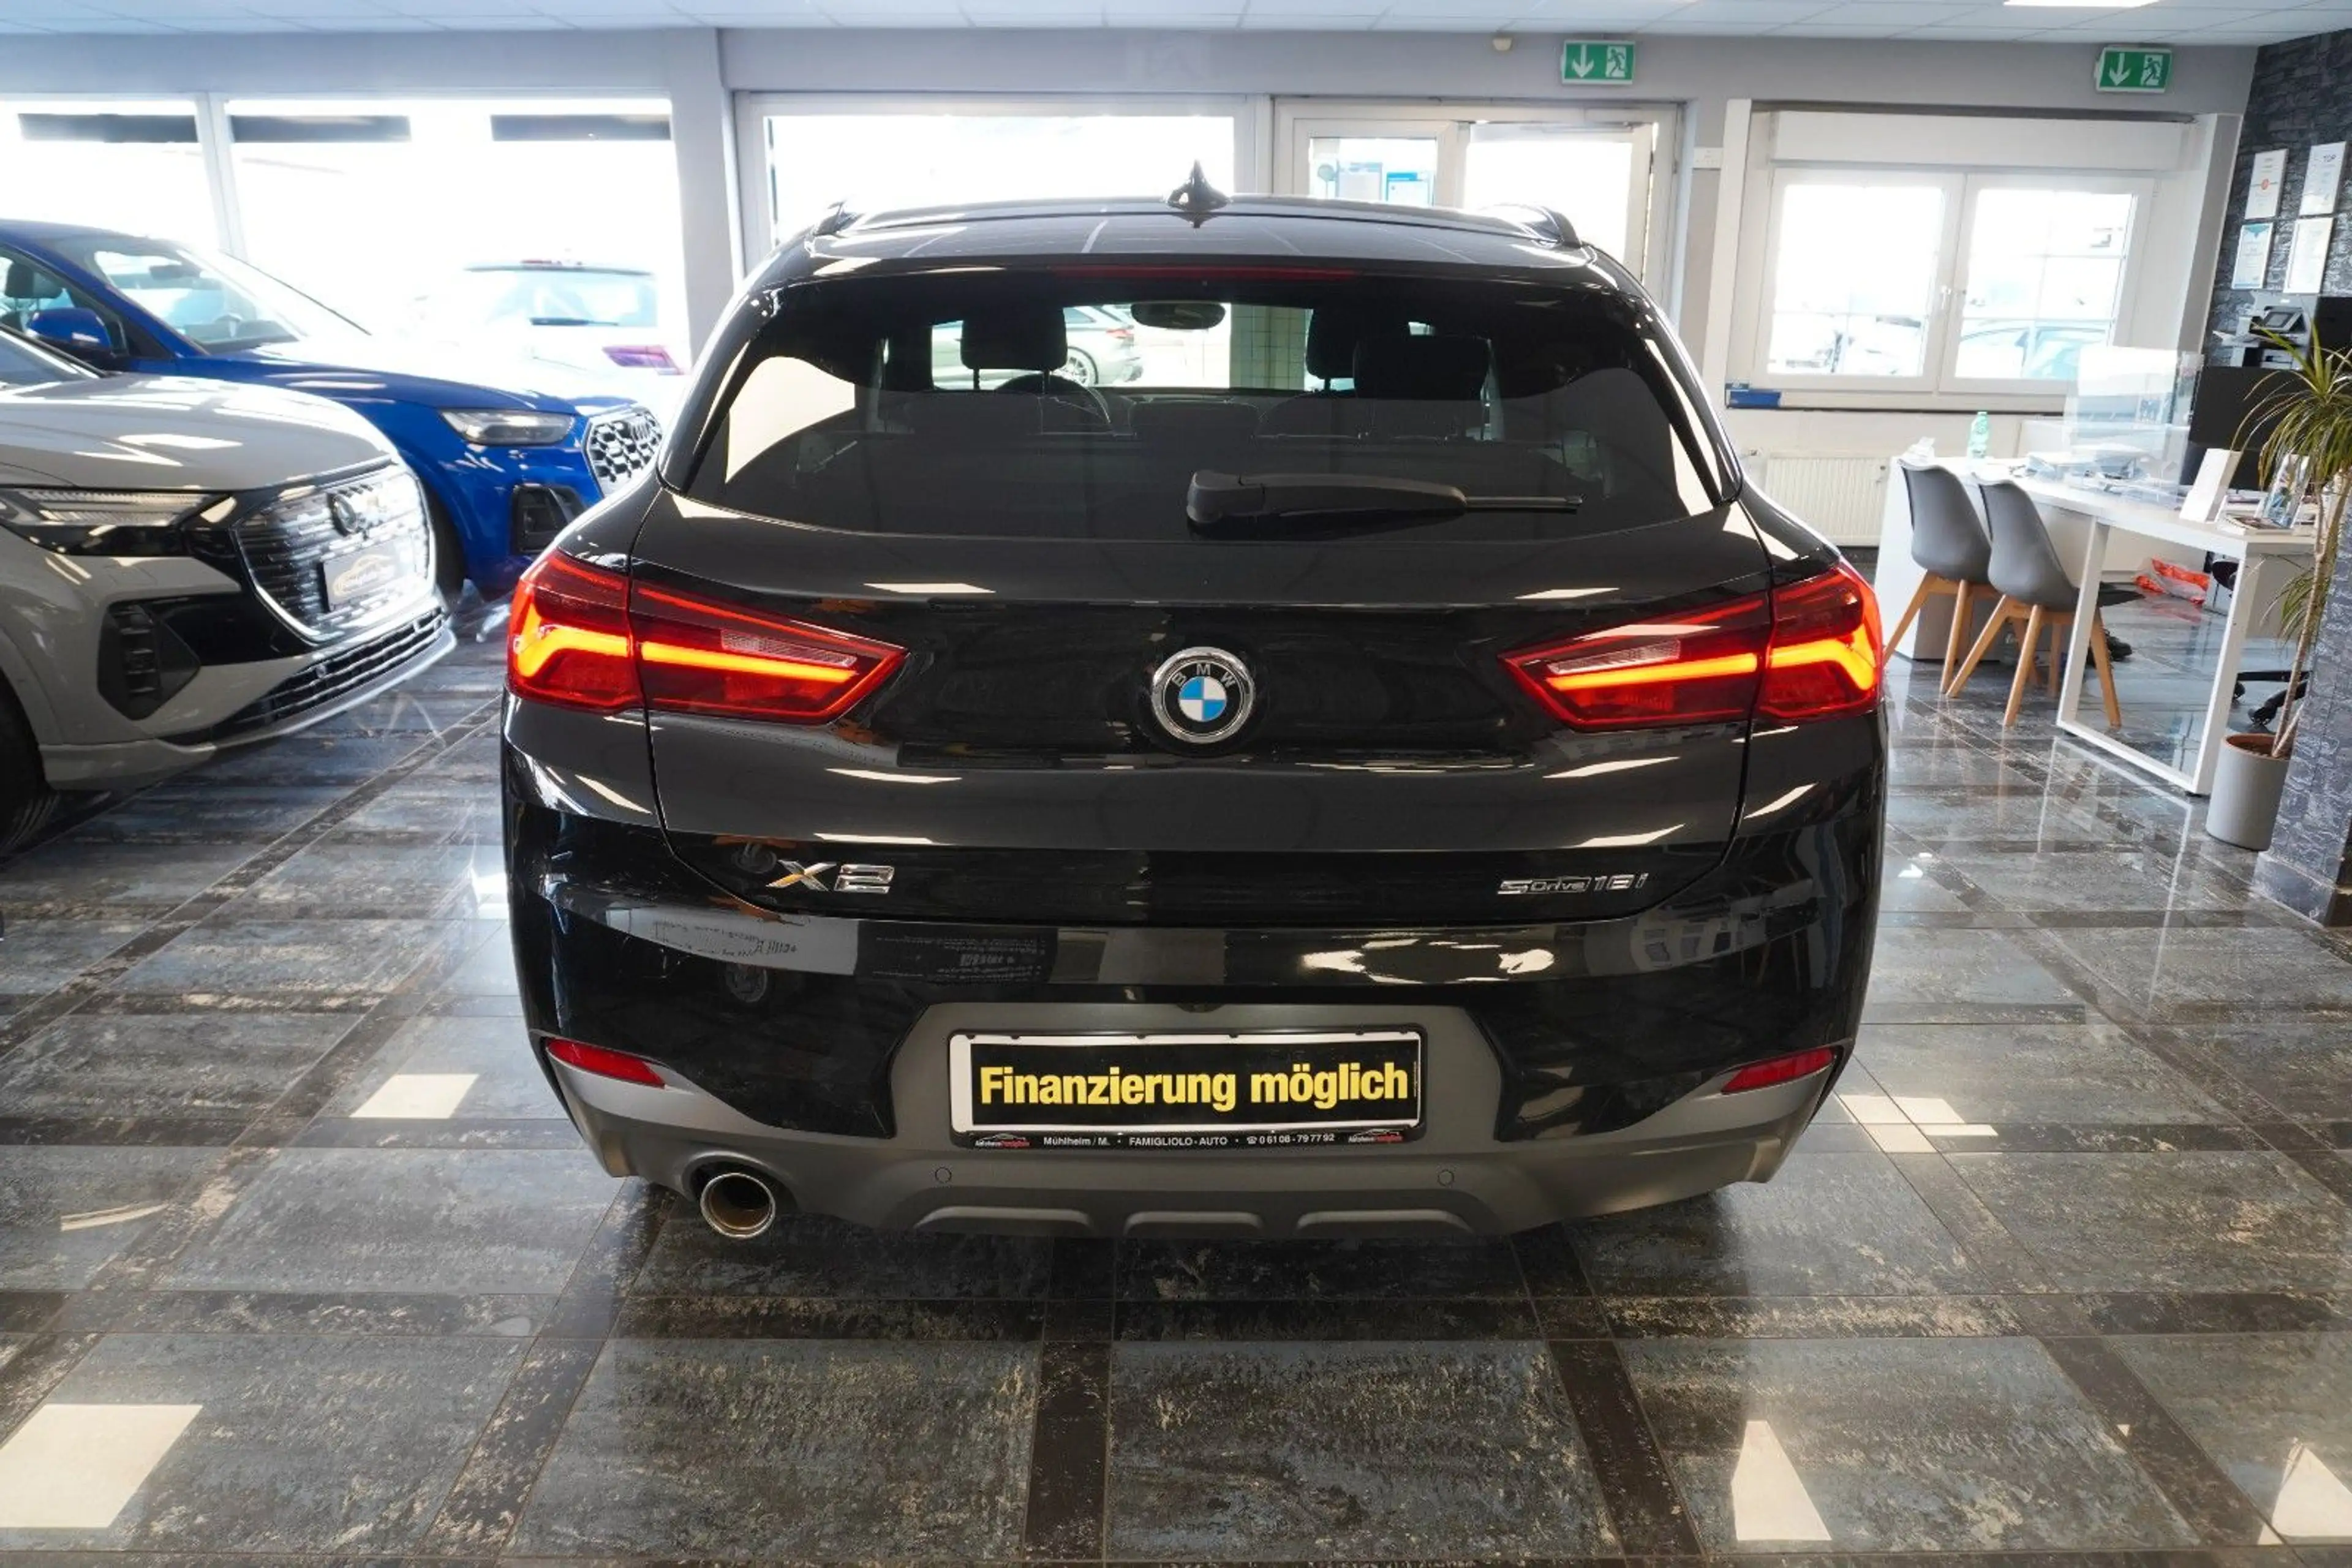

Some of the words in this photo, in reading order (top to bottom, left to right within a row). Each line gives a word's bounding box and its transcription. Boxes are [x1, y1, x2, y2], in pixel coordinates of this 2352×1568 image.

[1171, 663, 1236, 688] BMW
[766, 859, 895, 894] X2
[980, 1066, 1236, 1112] Finanzierung
[1251, 1062, 1408, 1109] möglich
